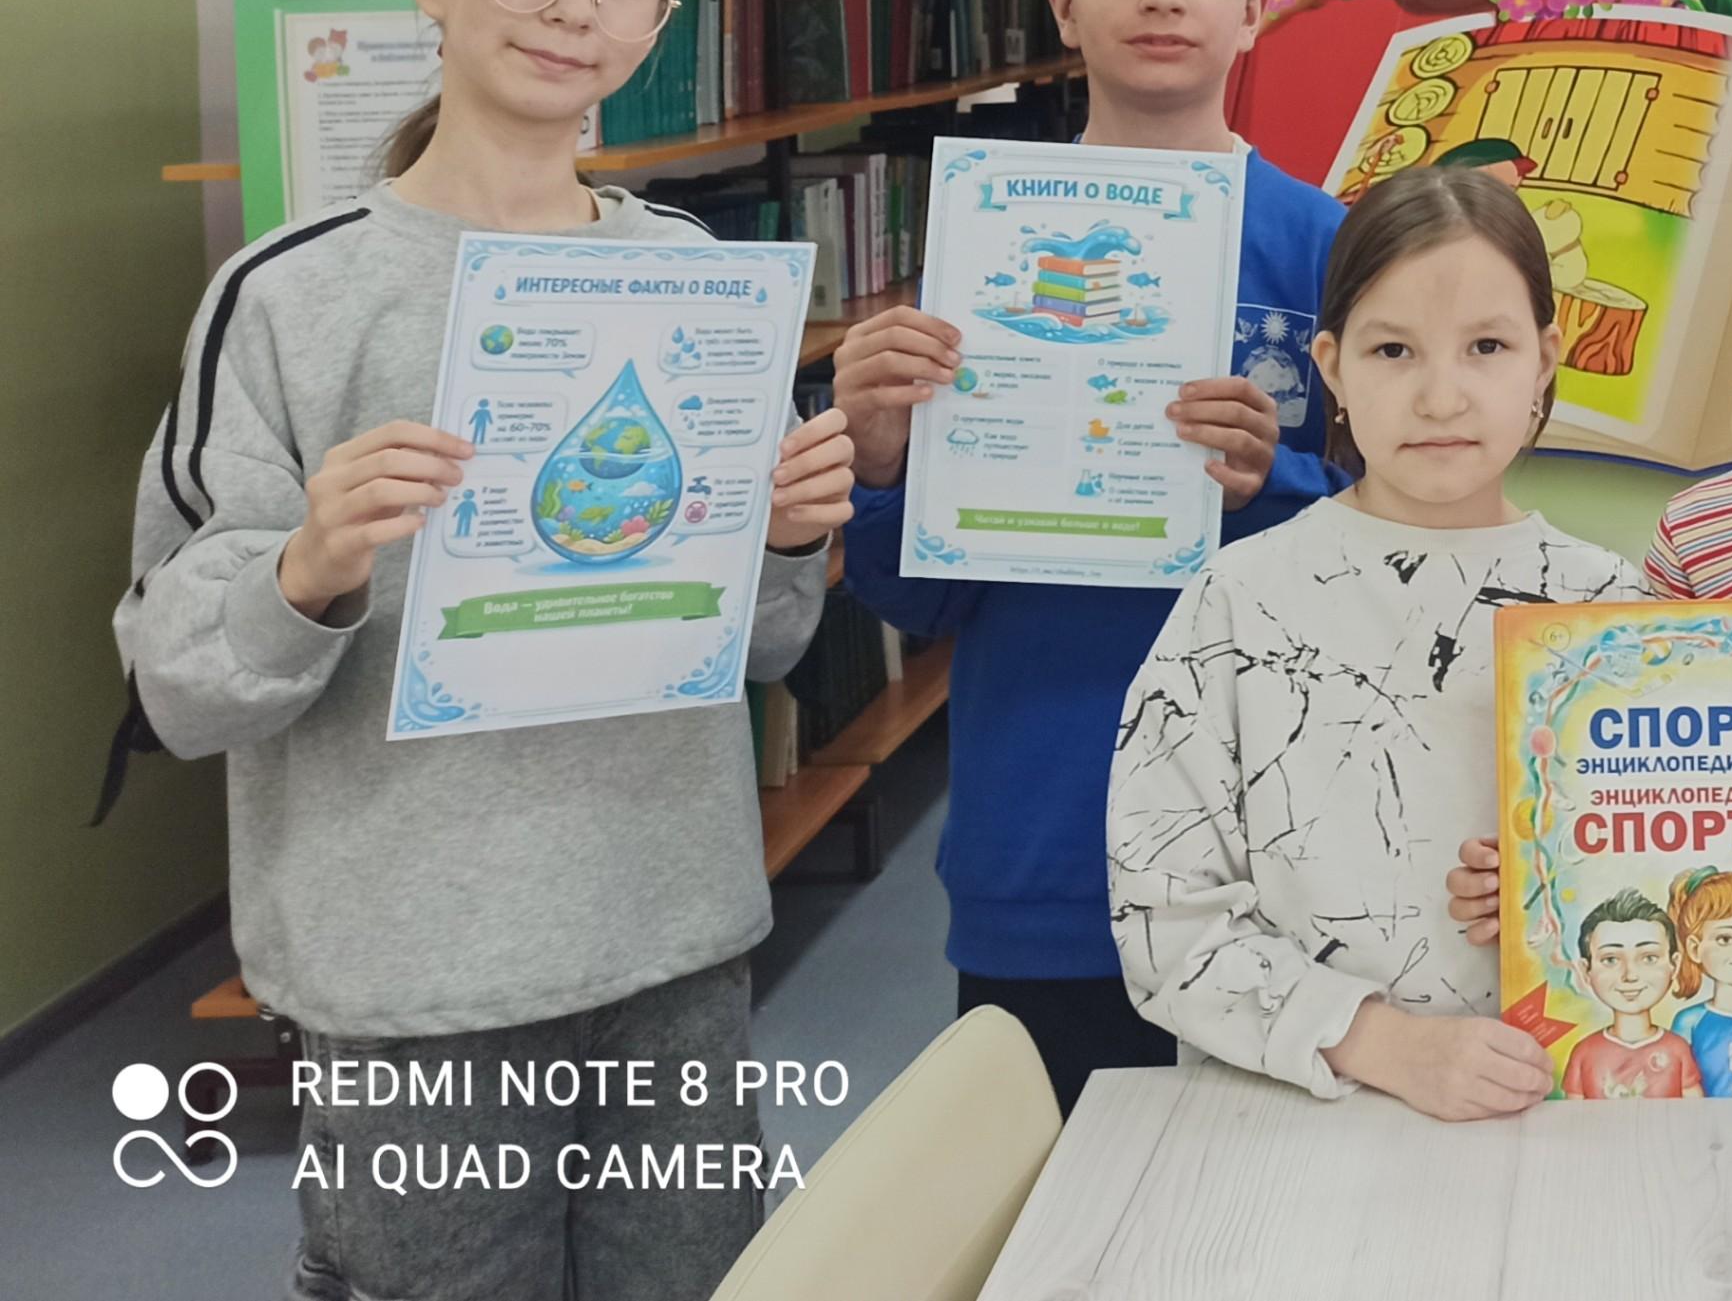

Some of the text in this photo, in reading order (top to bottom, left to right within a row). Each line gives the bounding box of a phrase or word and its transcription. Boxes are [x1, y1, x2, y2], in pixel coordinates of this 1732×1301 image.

[1006, 179, 1163, 205] КНИГИ О ВОДЕ
[515, 276, 752, 299] ИНТЕРЕСНЫЕ ФАКТЫ О ВОДЕ
[483, 600, 518, 615] Вода
